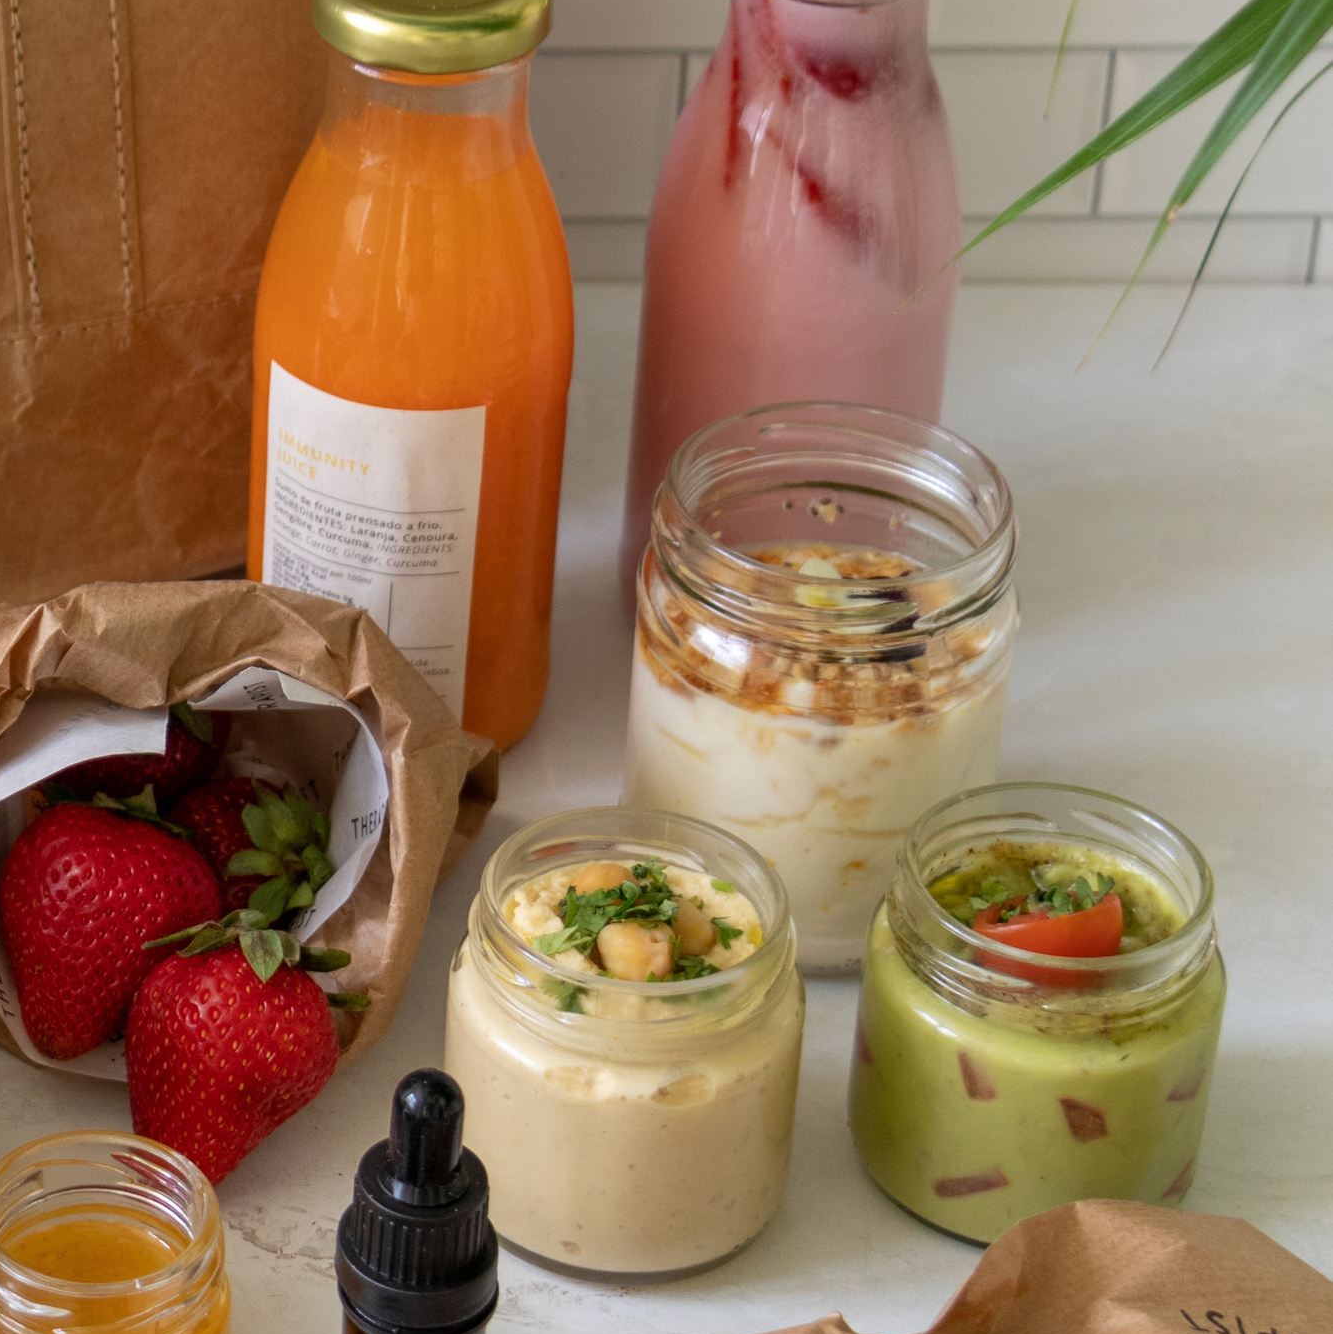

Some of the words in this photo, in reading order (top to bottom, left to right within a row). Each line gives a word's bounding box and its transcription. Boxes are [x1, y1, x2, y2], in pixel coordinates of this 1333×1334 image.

[277, 446, 317, 479] JUICE
[278, 427, 370, 476] IMMUNITY
[275, 477, 298, 498] Sumo
[300, 495, 311, 507] de
[315, 501, 341, 517] fruta
[345, 512, 402, 530] prensado
[406, 523, 414, 531] a
[417, 520, 442, 530] frio.
[350, 524, 398, 543] Laranja,
[403, 533, 458, 543] Cenoura,
